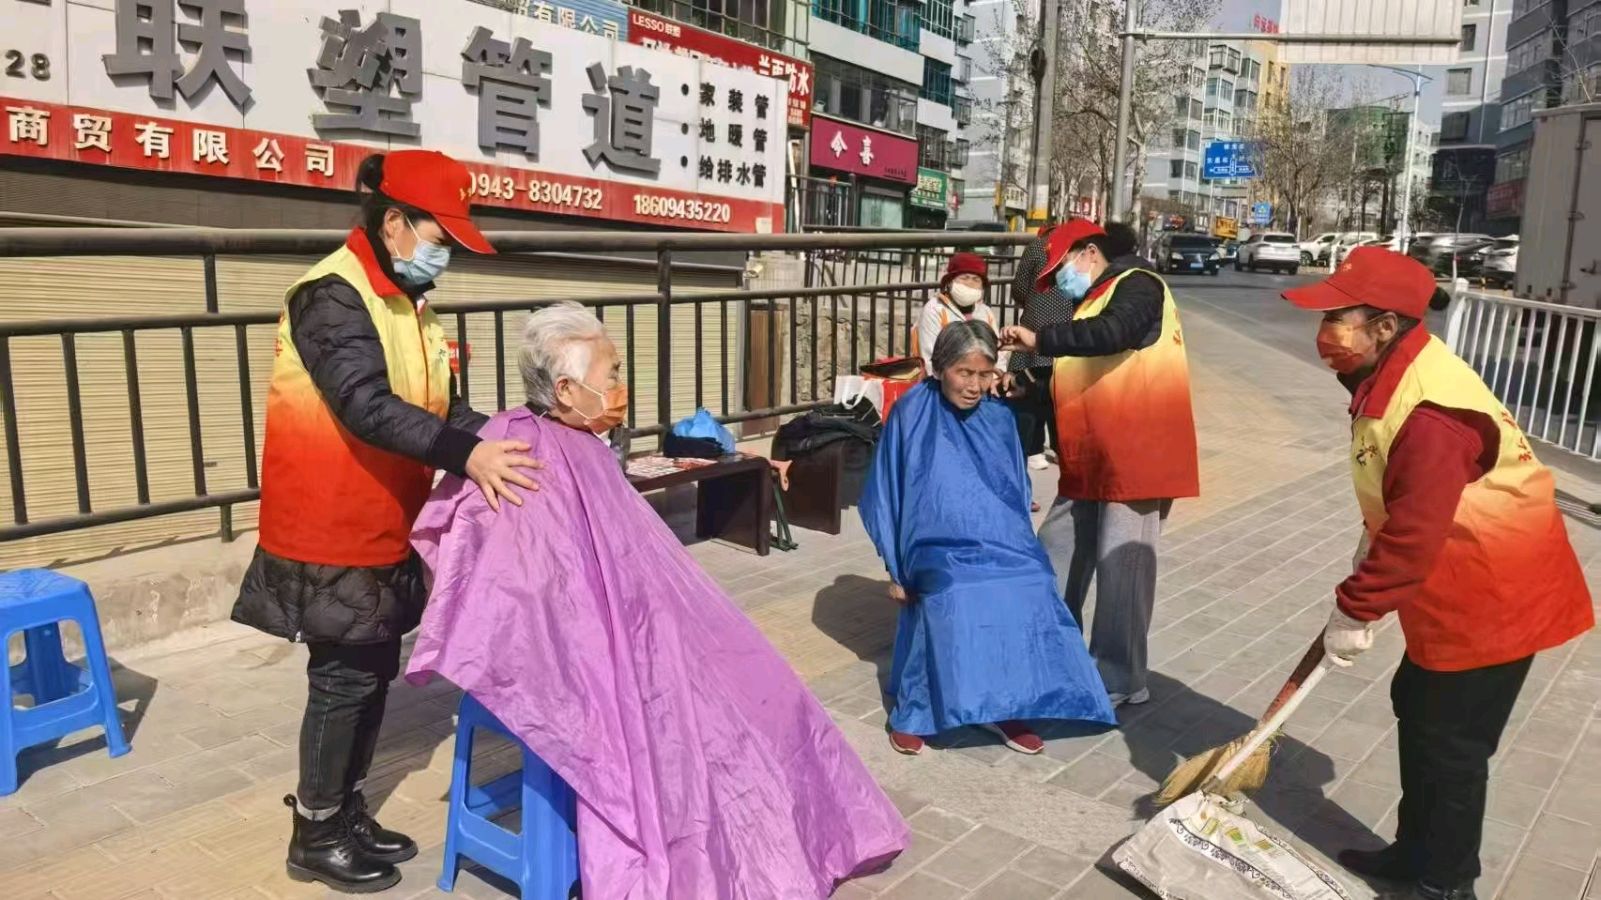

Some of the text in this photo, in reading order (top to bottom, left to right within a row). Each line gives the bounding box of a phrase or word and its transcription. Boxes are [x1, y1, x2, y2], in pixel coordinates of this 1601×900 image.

[632, 13, 665, 33] LESSO
[5, 49, 51, 82] 28
[102, 0, 661, 174] 联塑管道
[699, 82, 769, 120] 家装管
[5, 105, 335, 178] 商贸有限公司
[699, 117, 768, 154] 地暖管
[698, 154, 767, 188] 给排水管
[633, 193, 731, 223] 18609435220
